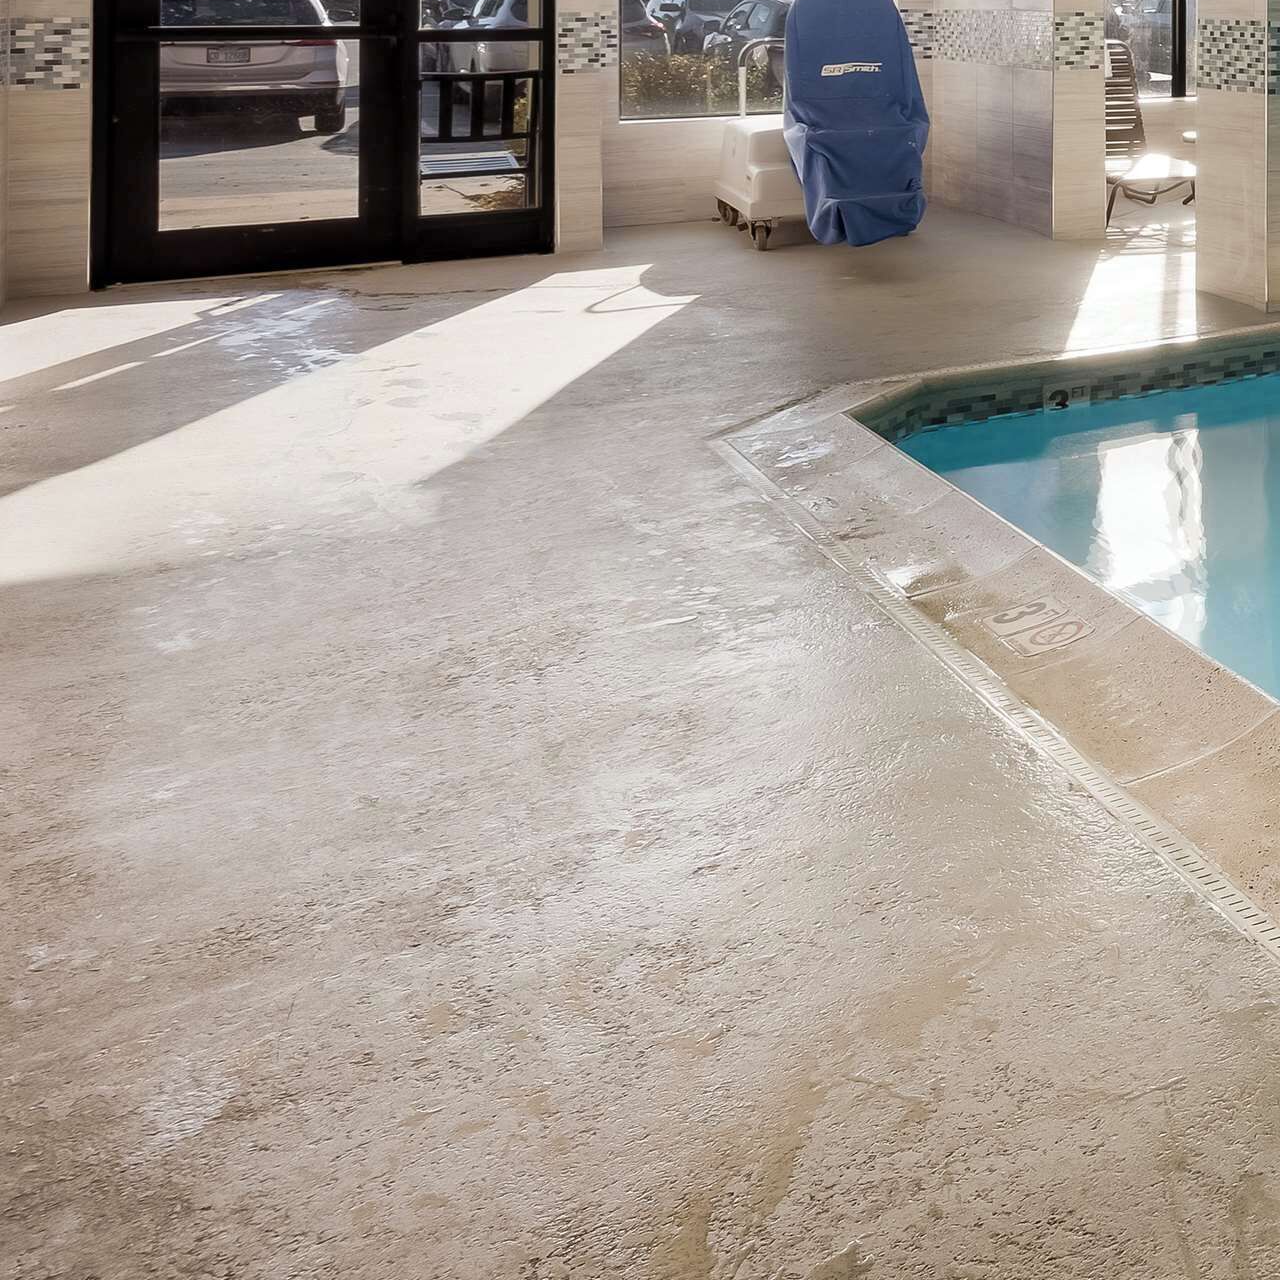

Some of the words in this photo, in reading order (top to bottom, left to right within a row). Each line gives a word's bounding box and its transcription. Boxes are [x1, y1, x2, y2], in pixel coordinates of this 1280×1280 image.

[1049, 389, 1070, 408] 3
[1072, 385, 1087, 399] FT
[993, 602, 1048, 624] 3
